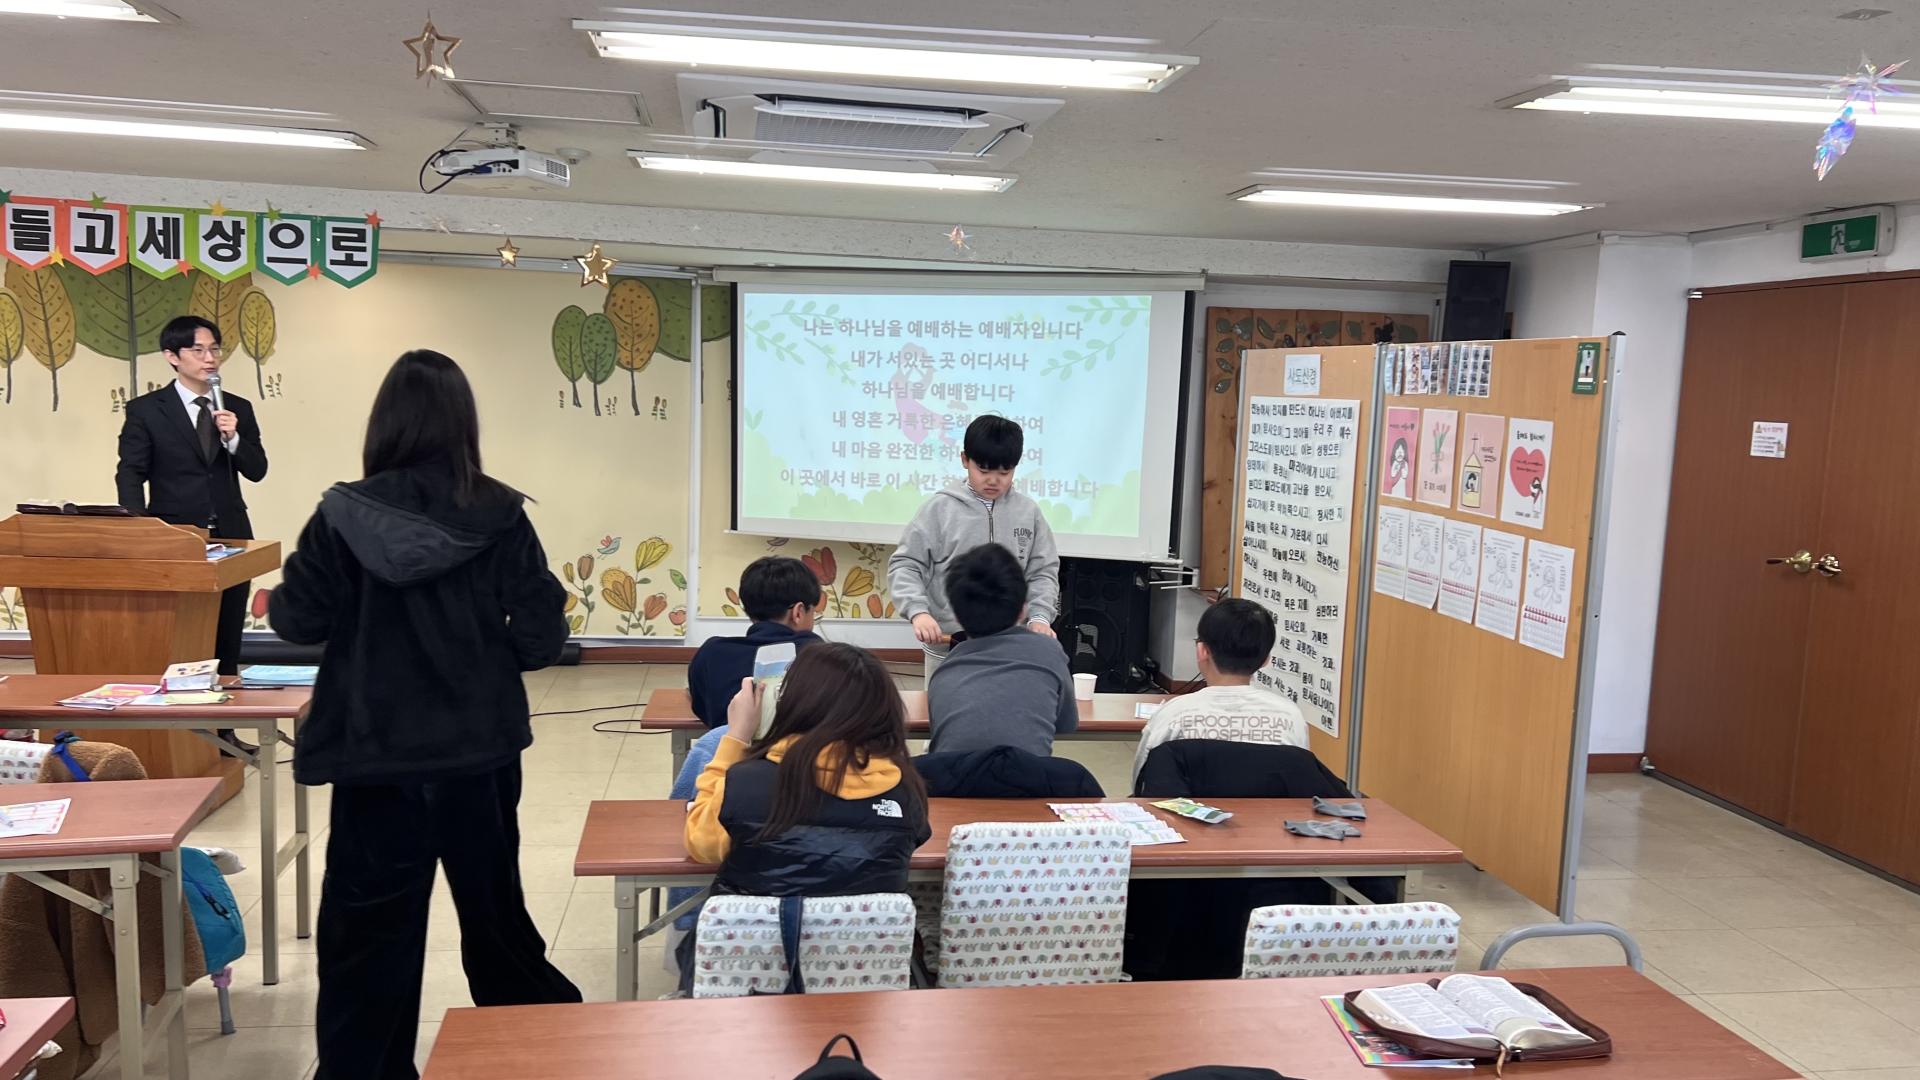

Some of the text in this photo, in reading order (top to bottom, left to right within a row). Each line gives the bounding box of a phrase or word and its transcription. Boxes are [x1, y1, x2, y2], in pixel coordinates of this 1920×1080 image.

[804, 319, 1083, 341] 나는 하나님을 예배하는 예배자입니다
[851, 351, 1028, 371] 내가 서있는 곳 어디서나
[1288, 367, 1317, 385] 사도신경
[862, 381, 1015, 402] 하나님을 예배합니다
[833, 412, 847, 428] 내
[852, 411, 883, 430] 영혼
[886, 412, 938, 431] 거룩한
[1313, 422, 1324, 435] 우리
[832, 442, 847, 459] 내
[852, 442, 882, 460] 마음
[886, 443, 935, 461] 완전한
[781, 469, 794, 486] 이
[799, 470, 846, 489] 곳에서
[850, 471, 882, 490] 바로
[886, 471, 901, 490] 이
[906, 472, 938, 492] 시간
[1178, 728, 1281, 743] ATMOSPHERE
